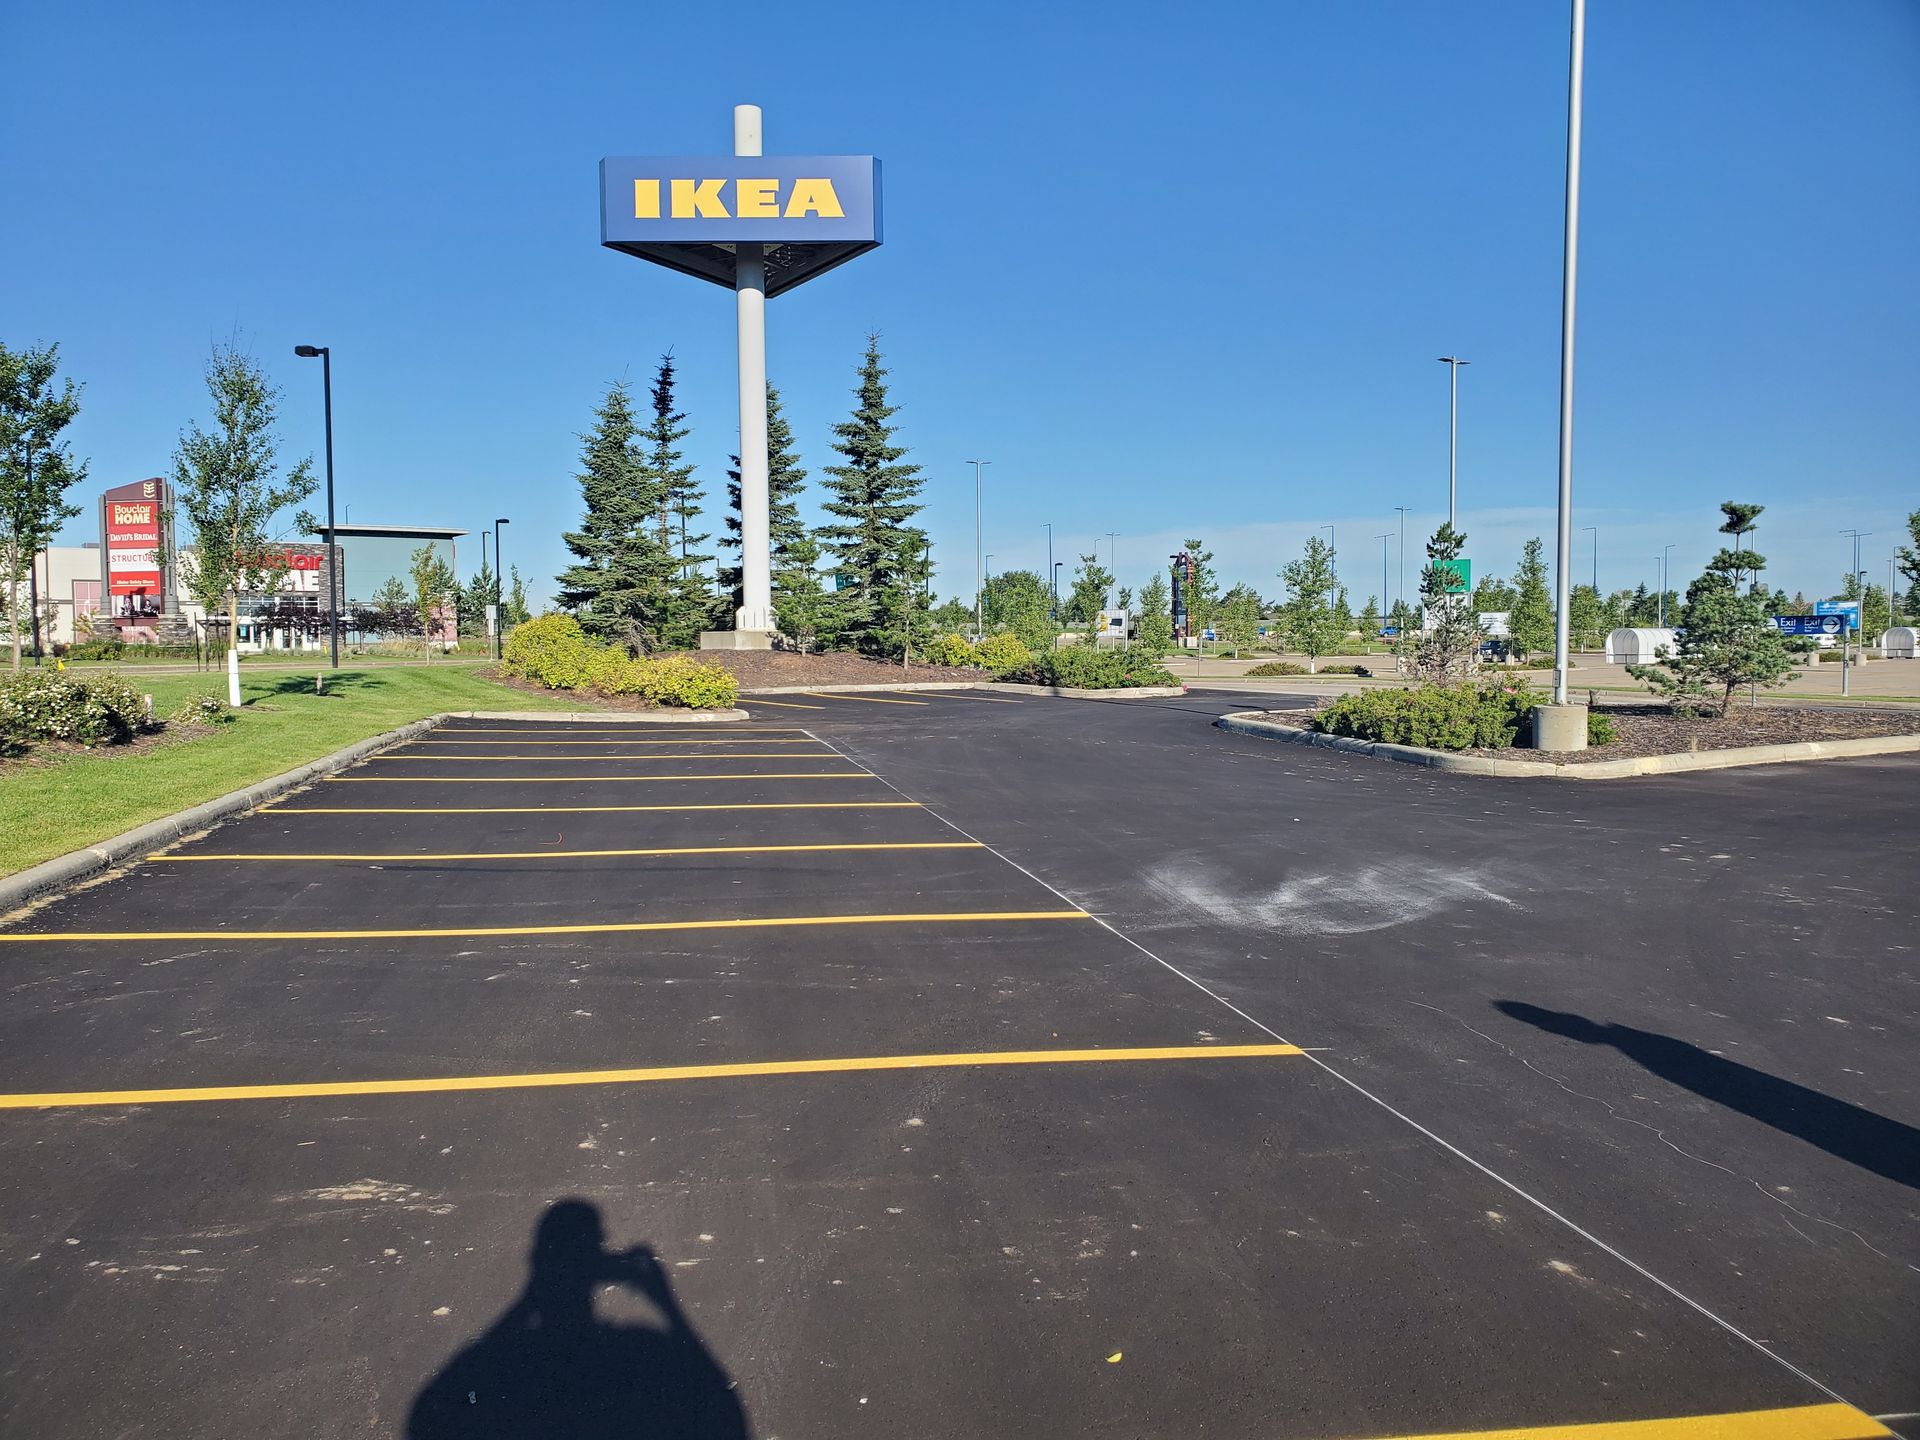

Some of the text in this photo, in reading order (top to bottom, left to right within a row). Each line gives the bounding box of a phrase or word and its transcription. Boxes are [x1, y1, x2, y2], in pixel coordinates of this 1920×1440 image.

[634, 178, 846, 219] IKEA
[115, 504, 151, 514] Bouclair
[115, 513, 151, 525] HOME
[133, 532, 158, 541] BRIDAL
[1780, 617, 1796, 626] Exit
[1804, 617, 1820, 626] Exit
